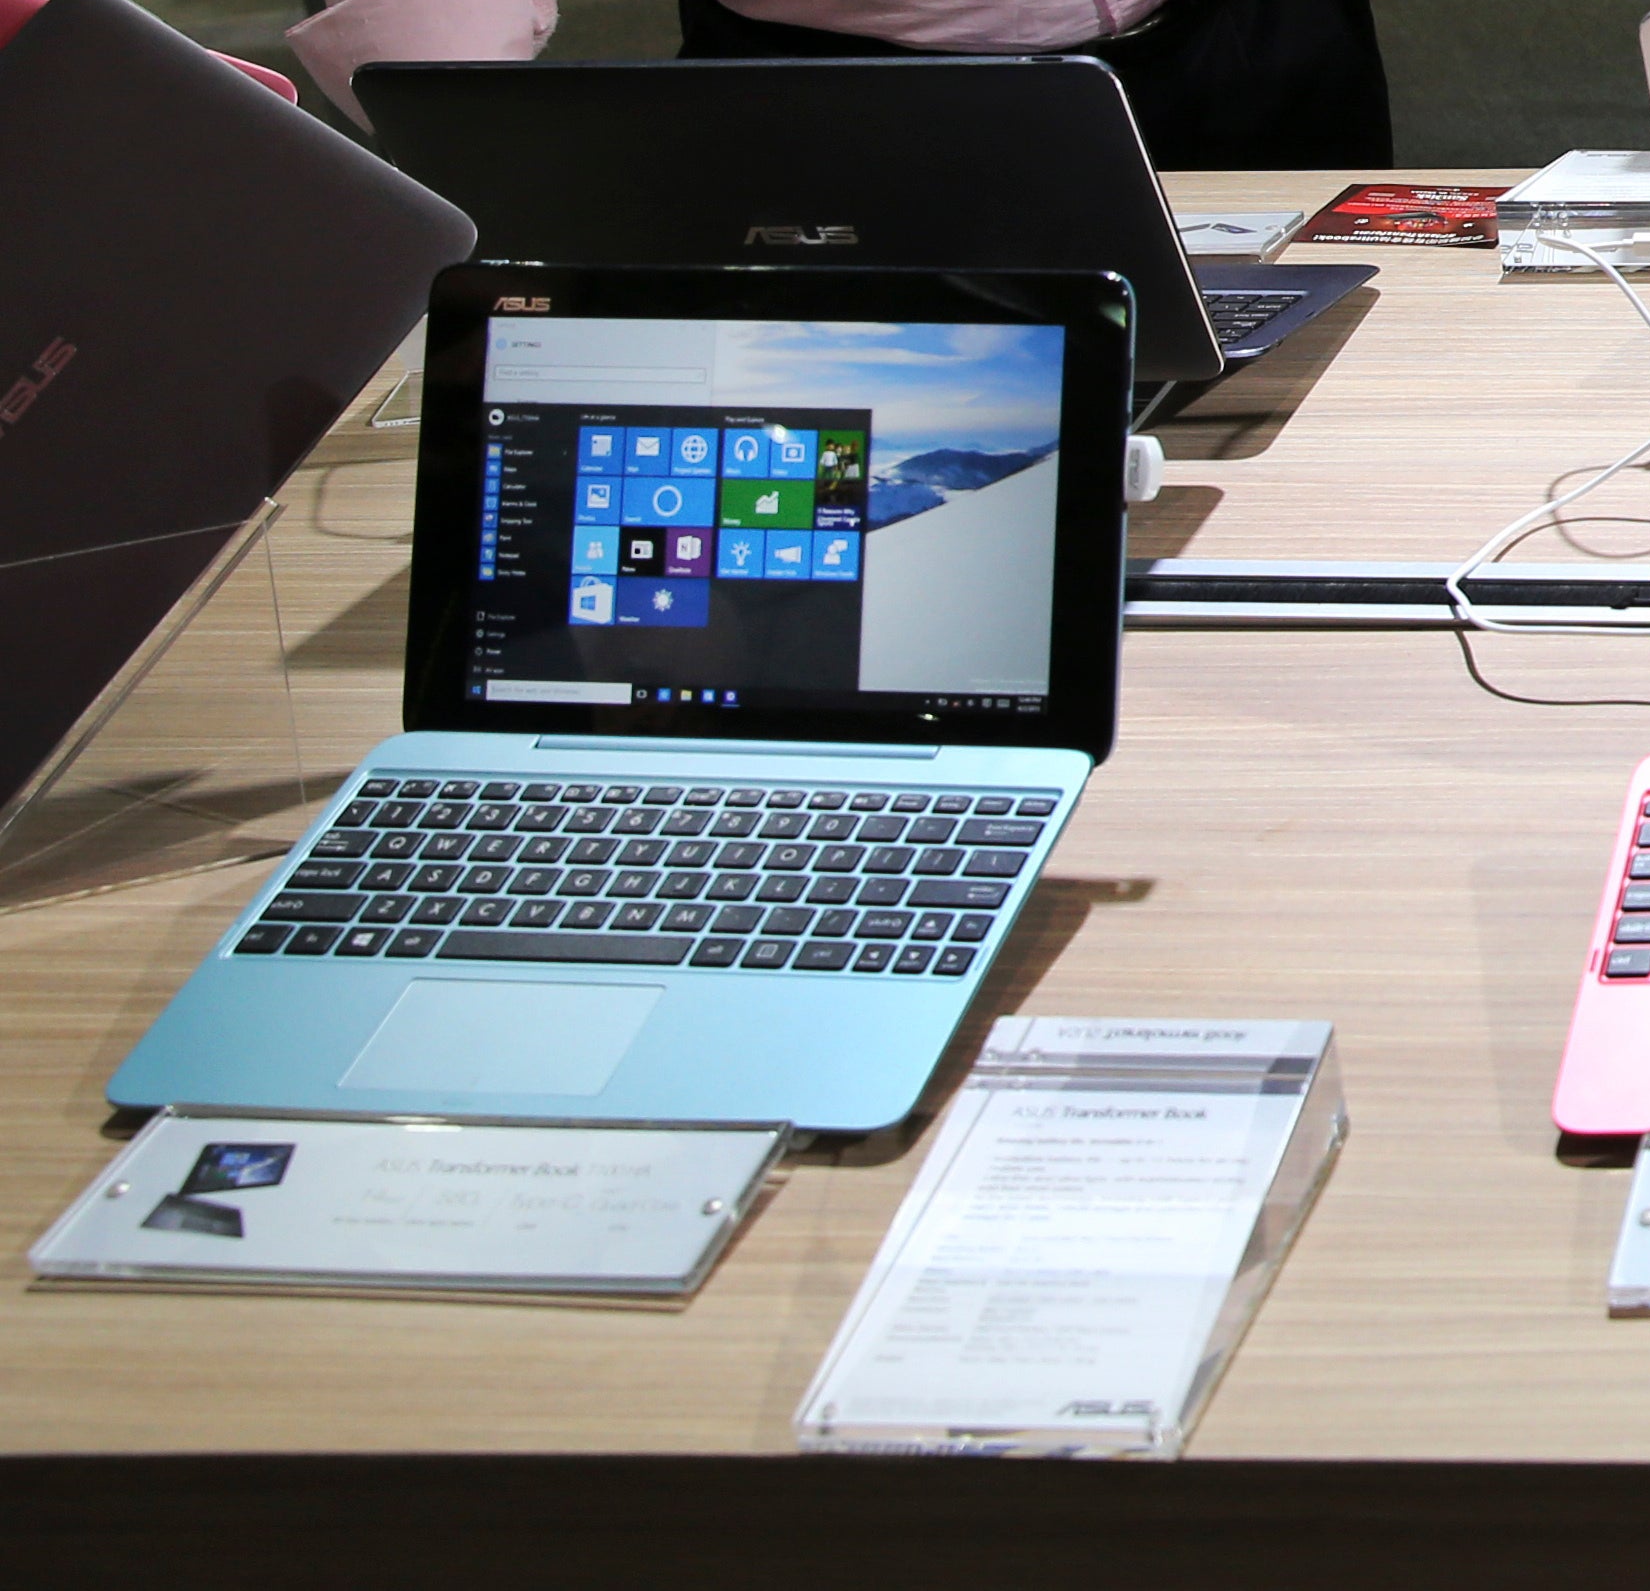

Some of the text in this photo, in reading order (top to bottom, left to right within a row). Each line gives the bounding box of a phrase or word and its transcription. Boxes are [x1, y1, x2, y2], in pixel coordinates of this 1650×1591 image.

[744, 225, 859, 246] ASUS
[493, 296, 551, 312] ASUS
[0, 338, 78, 438] SUS
[1061, 1107, 1161, 1120] Transformer
[1163, 1108, 1208, 1120] Book
[428, 1158, 531, 1176] Transformer
[533, 1160, 580, 1177] Book
[1057, 1399, 1155, 1417] ASUS
